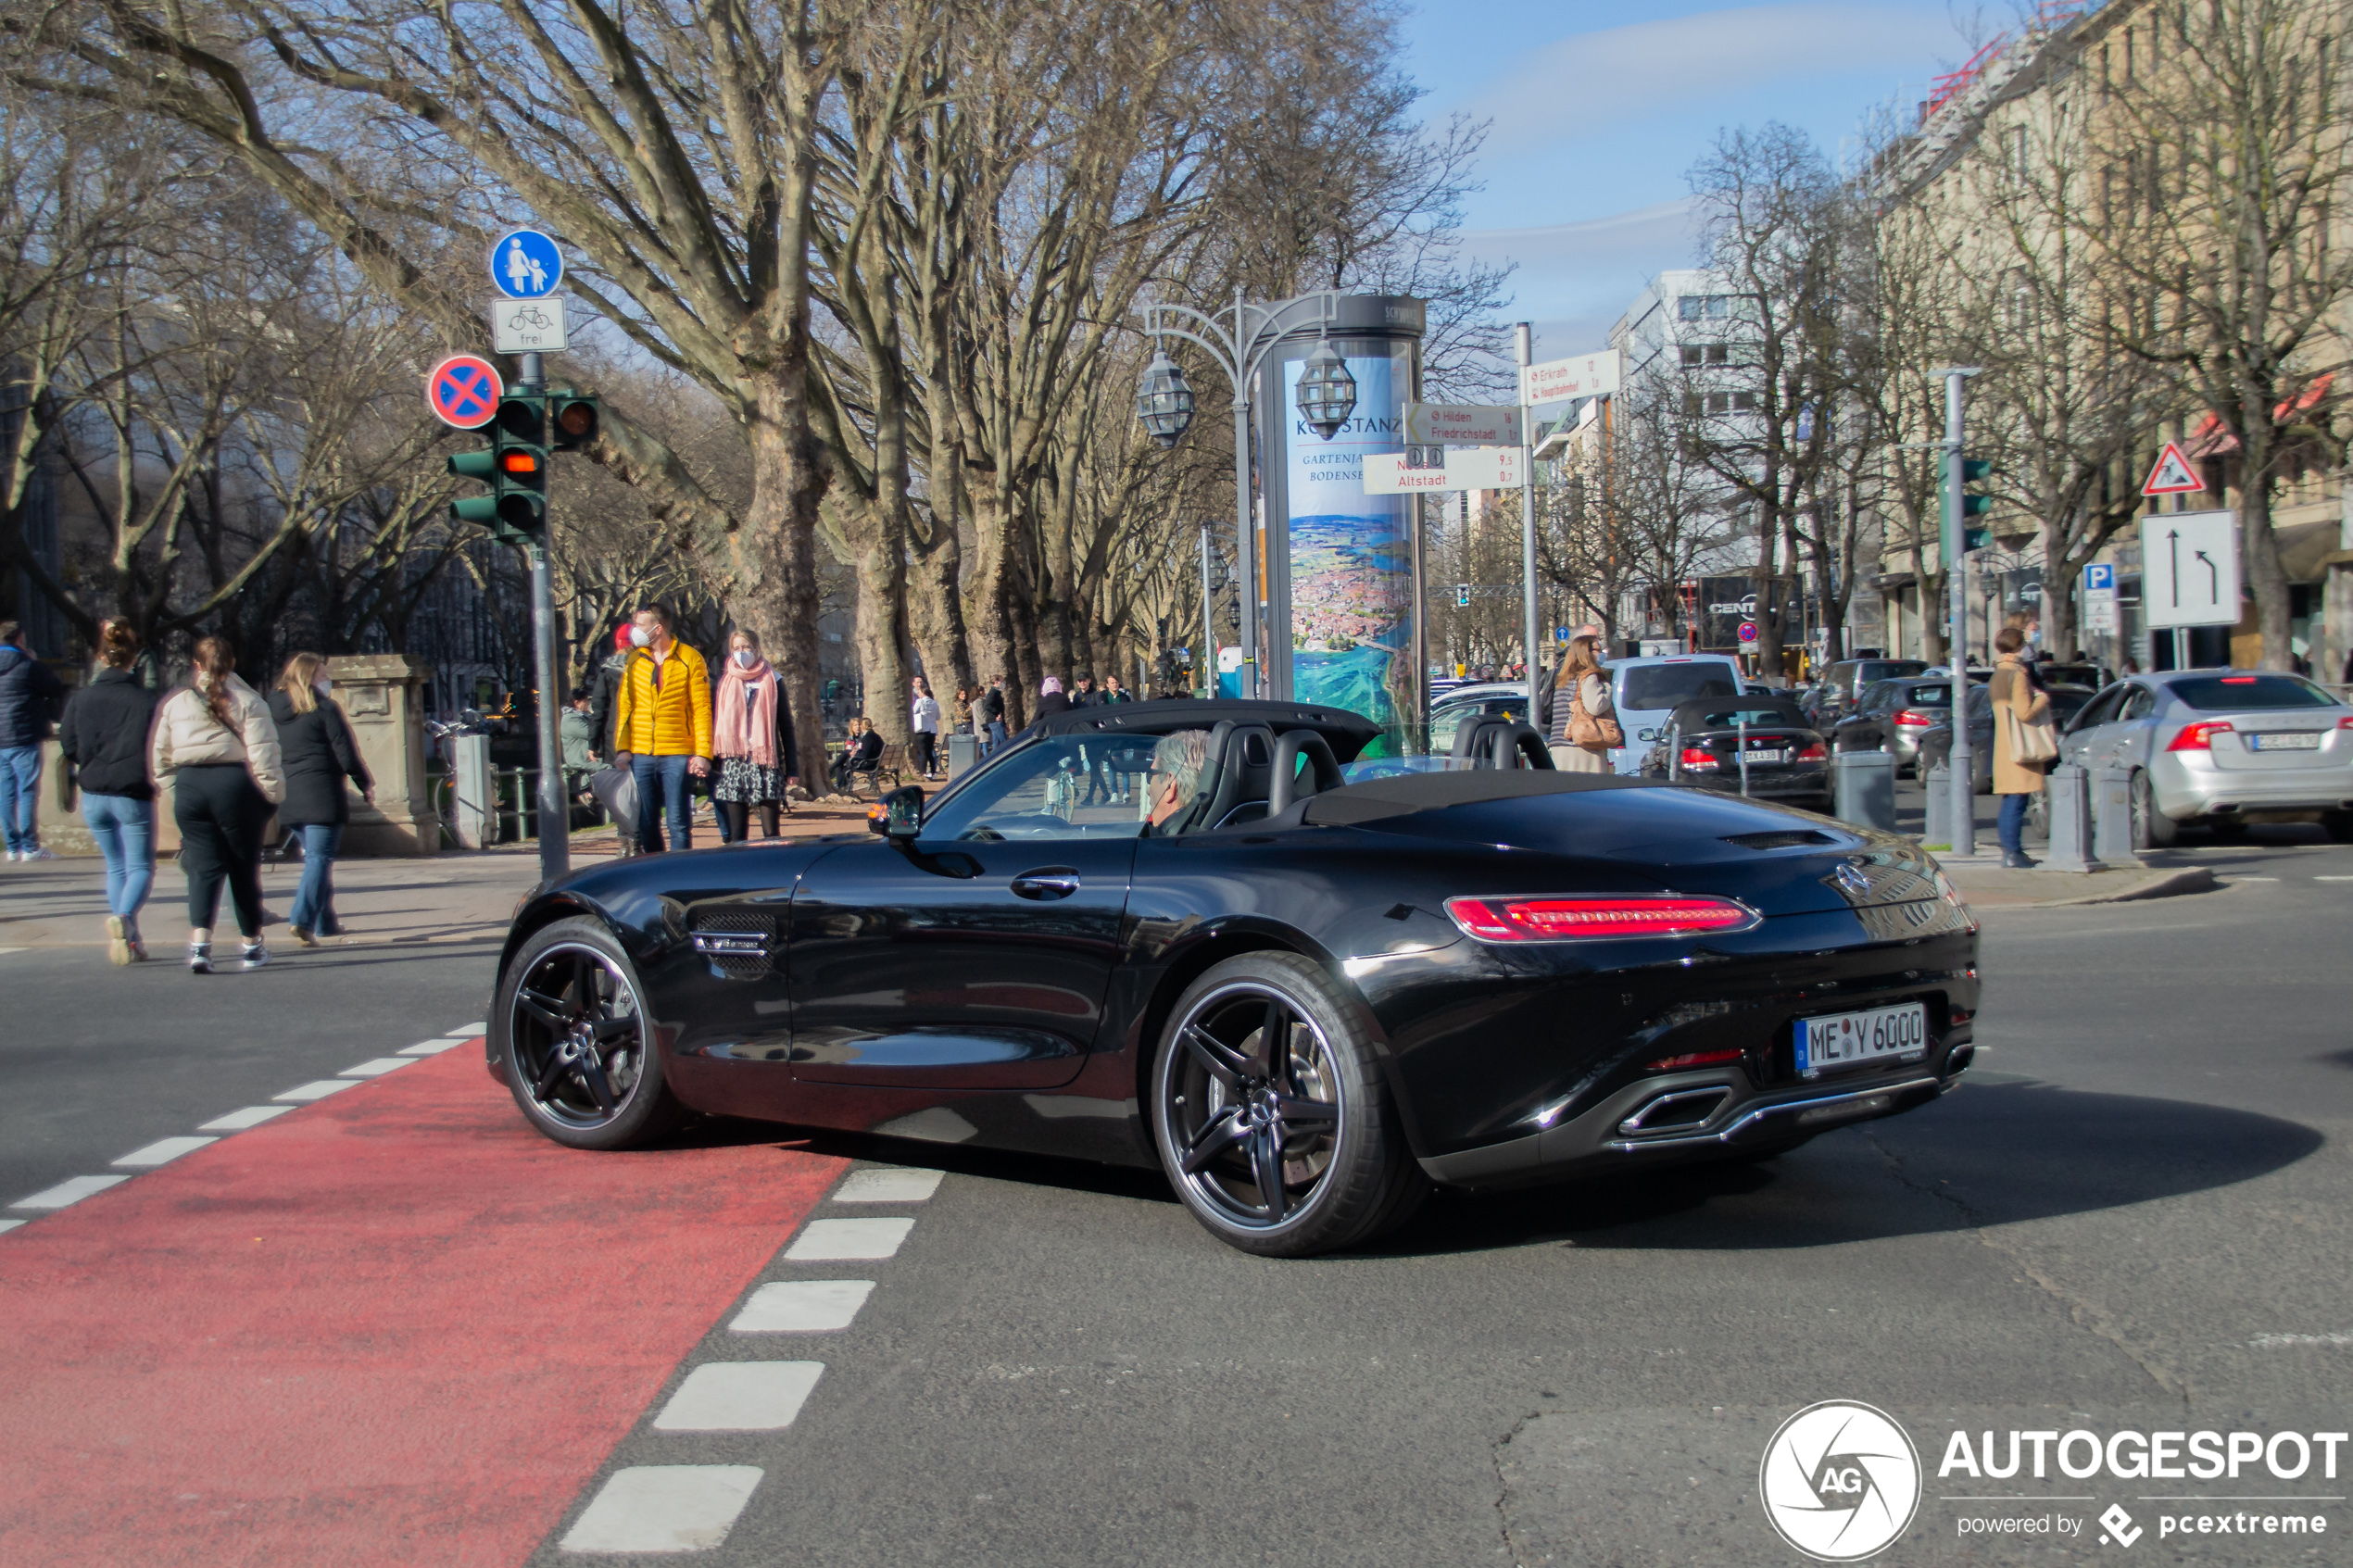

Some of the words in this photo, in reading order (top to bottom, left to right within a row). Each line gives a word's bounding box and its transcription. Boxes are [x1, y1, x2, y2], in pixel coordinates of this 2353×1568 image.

[520, 333, 543, 345] frei
[1540, 368, 1567, 382] Erkrath
[1588, 360, 1594, 371] 12
[1541, 381, 1579, 398] Hauptbahnhof
[1443, 410, 1472, 422] Hilden
[1504, 412, 1512, 424] 16
[1297, 418, 1402, 435] KSTANZ
[1431, 427, 1496, 440] Friedrichstadt
[1302, 453, 1379, 465] GARTENJA
[1310, 470, 1364, 482] BODENSE
[1398, 474, 1447, 487] Altstadt
[1809, 1022, 1841, 1061] ME
